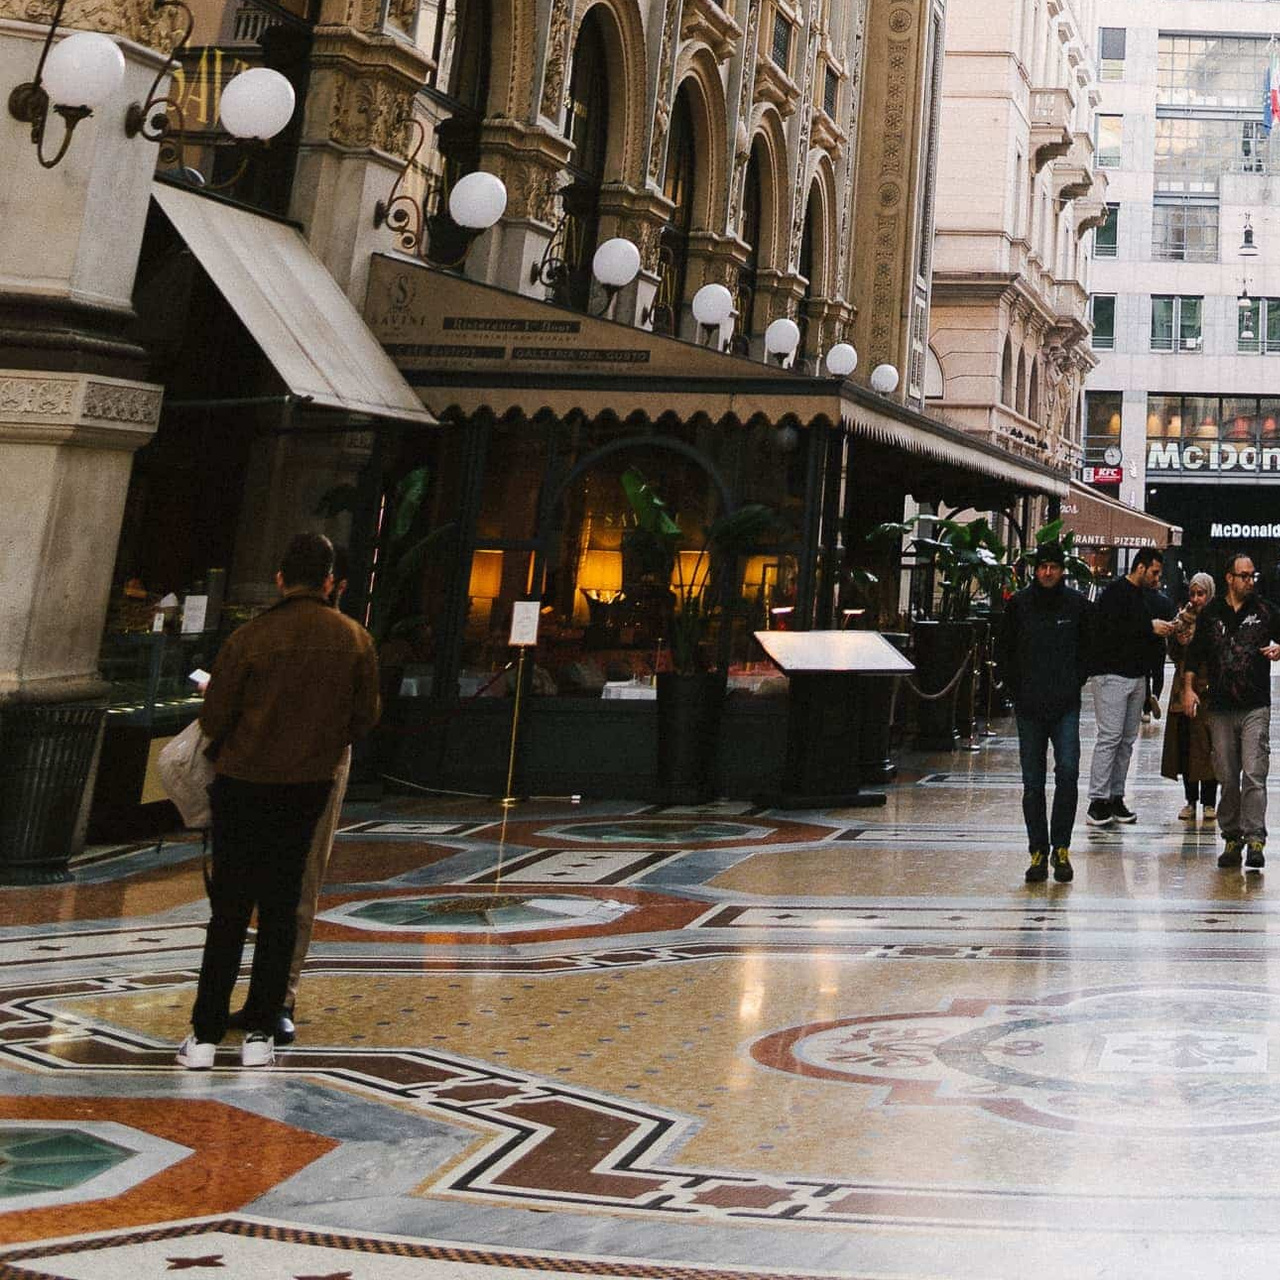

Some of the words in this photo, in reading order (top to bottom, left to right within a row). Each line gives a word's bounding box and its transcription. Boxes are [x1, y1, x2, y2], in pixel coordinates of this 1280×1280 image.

[578, 351, 603, 360] DEL
[1099, 468, 1118, 476] KFC
[1114, 536, 1157, 548] PIZZERIA
